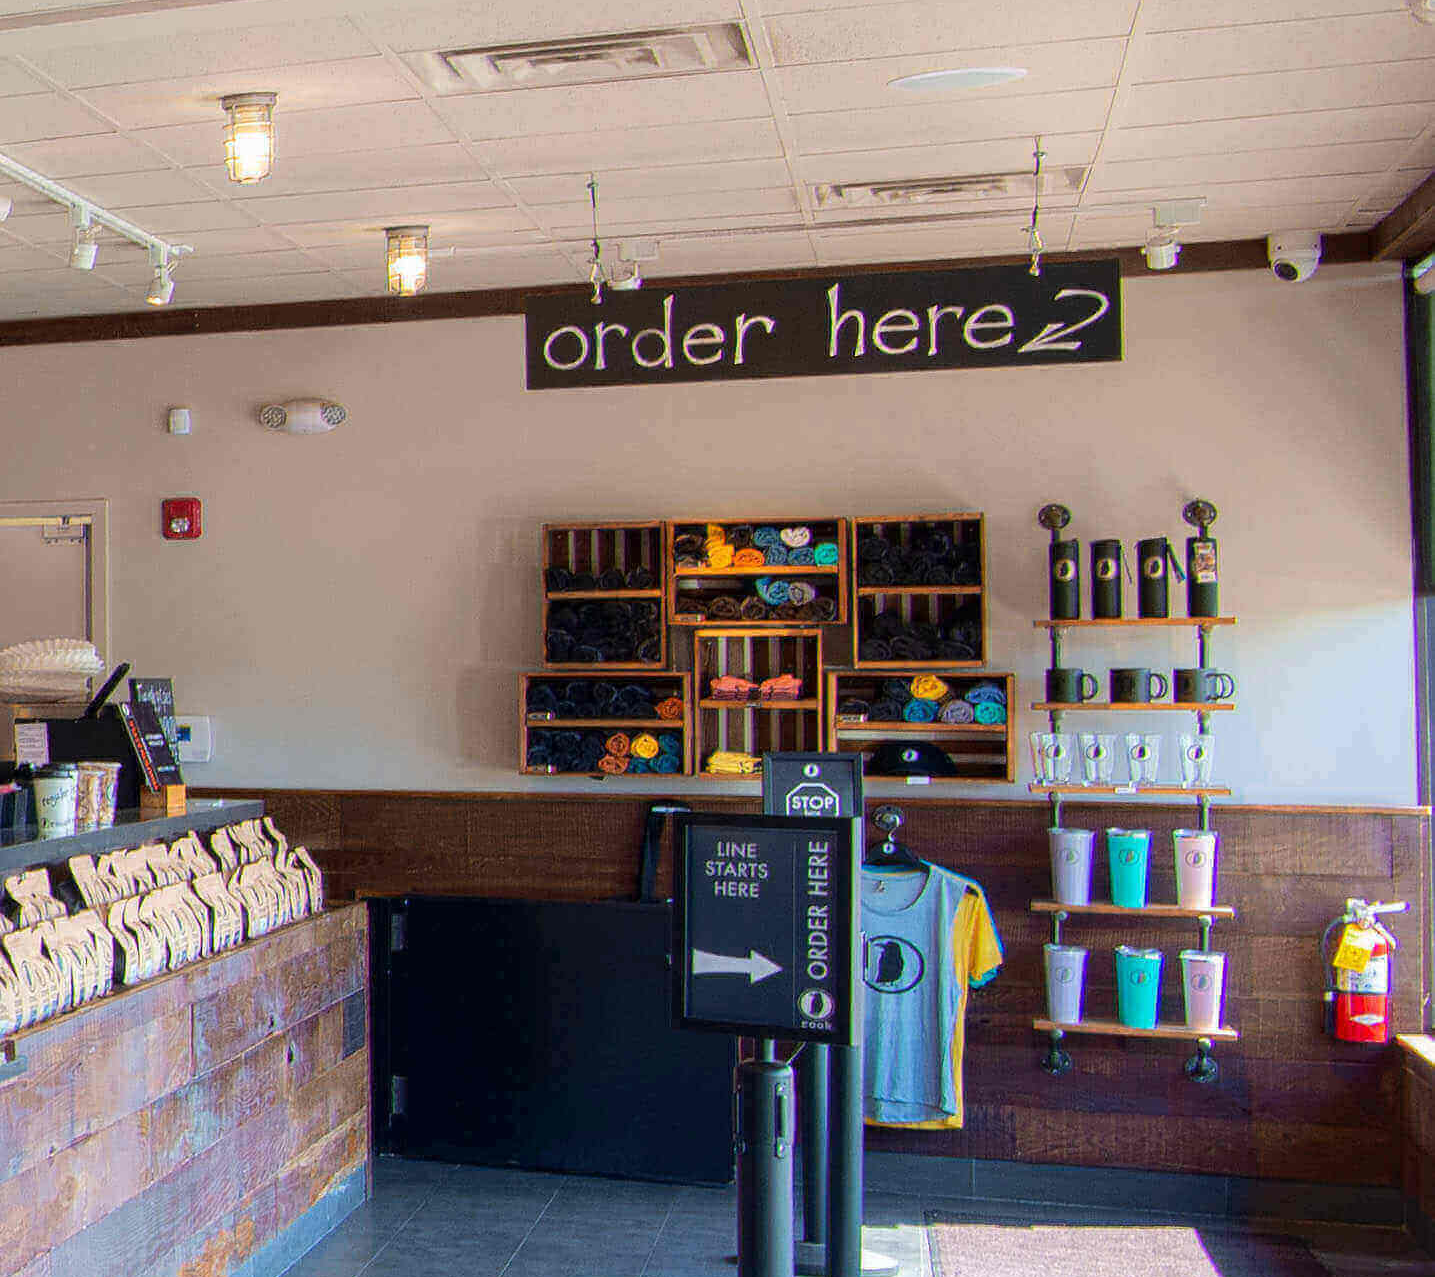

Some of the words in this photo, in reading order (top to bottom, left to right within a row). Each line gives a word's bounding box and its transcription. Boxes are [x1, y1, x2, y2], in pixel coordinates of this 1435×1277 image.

[543, 294, 775, 371] order
[827, 283, 1016, 357] here
[791, 795, 834, 810] STOP
[717, 841, 757, 859] LINE
[705, 861, 768, 879] STARTS
[808, 841, 829, 896] HERE
[714, 881, 760, 898] HERE
[807, 905, 829, 980] ORDER
